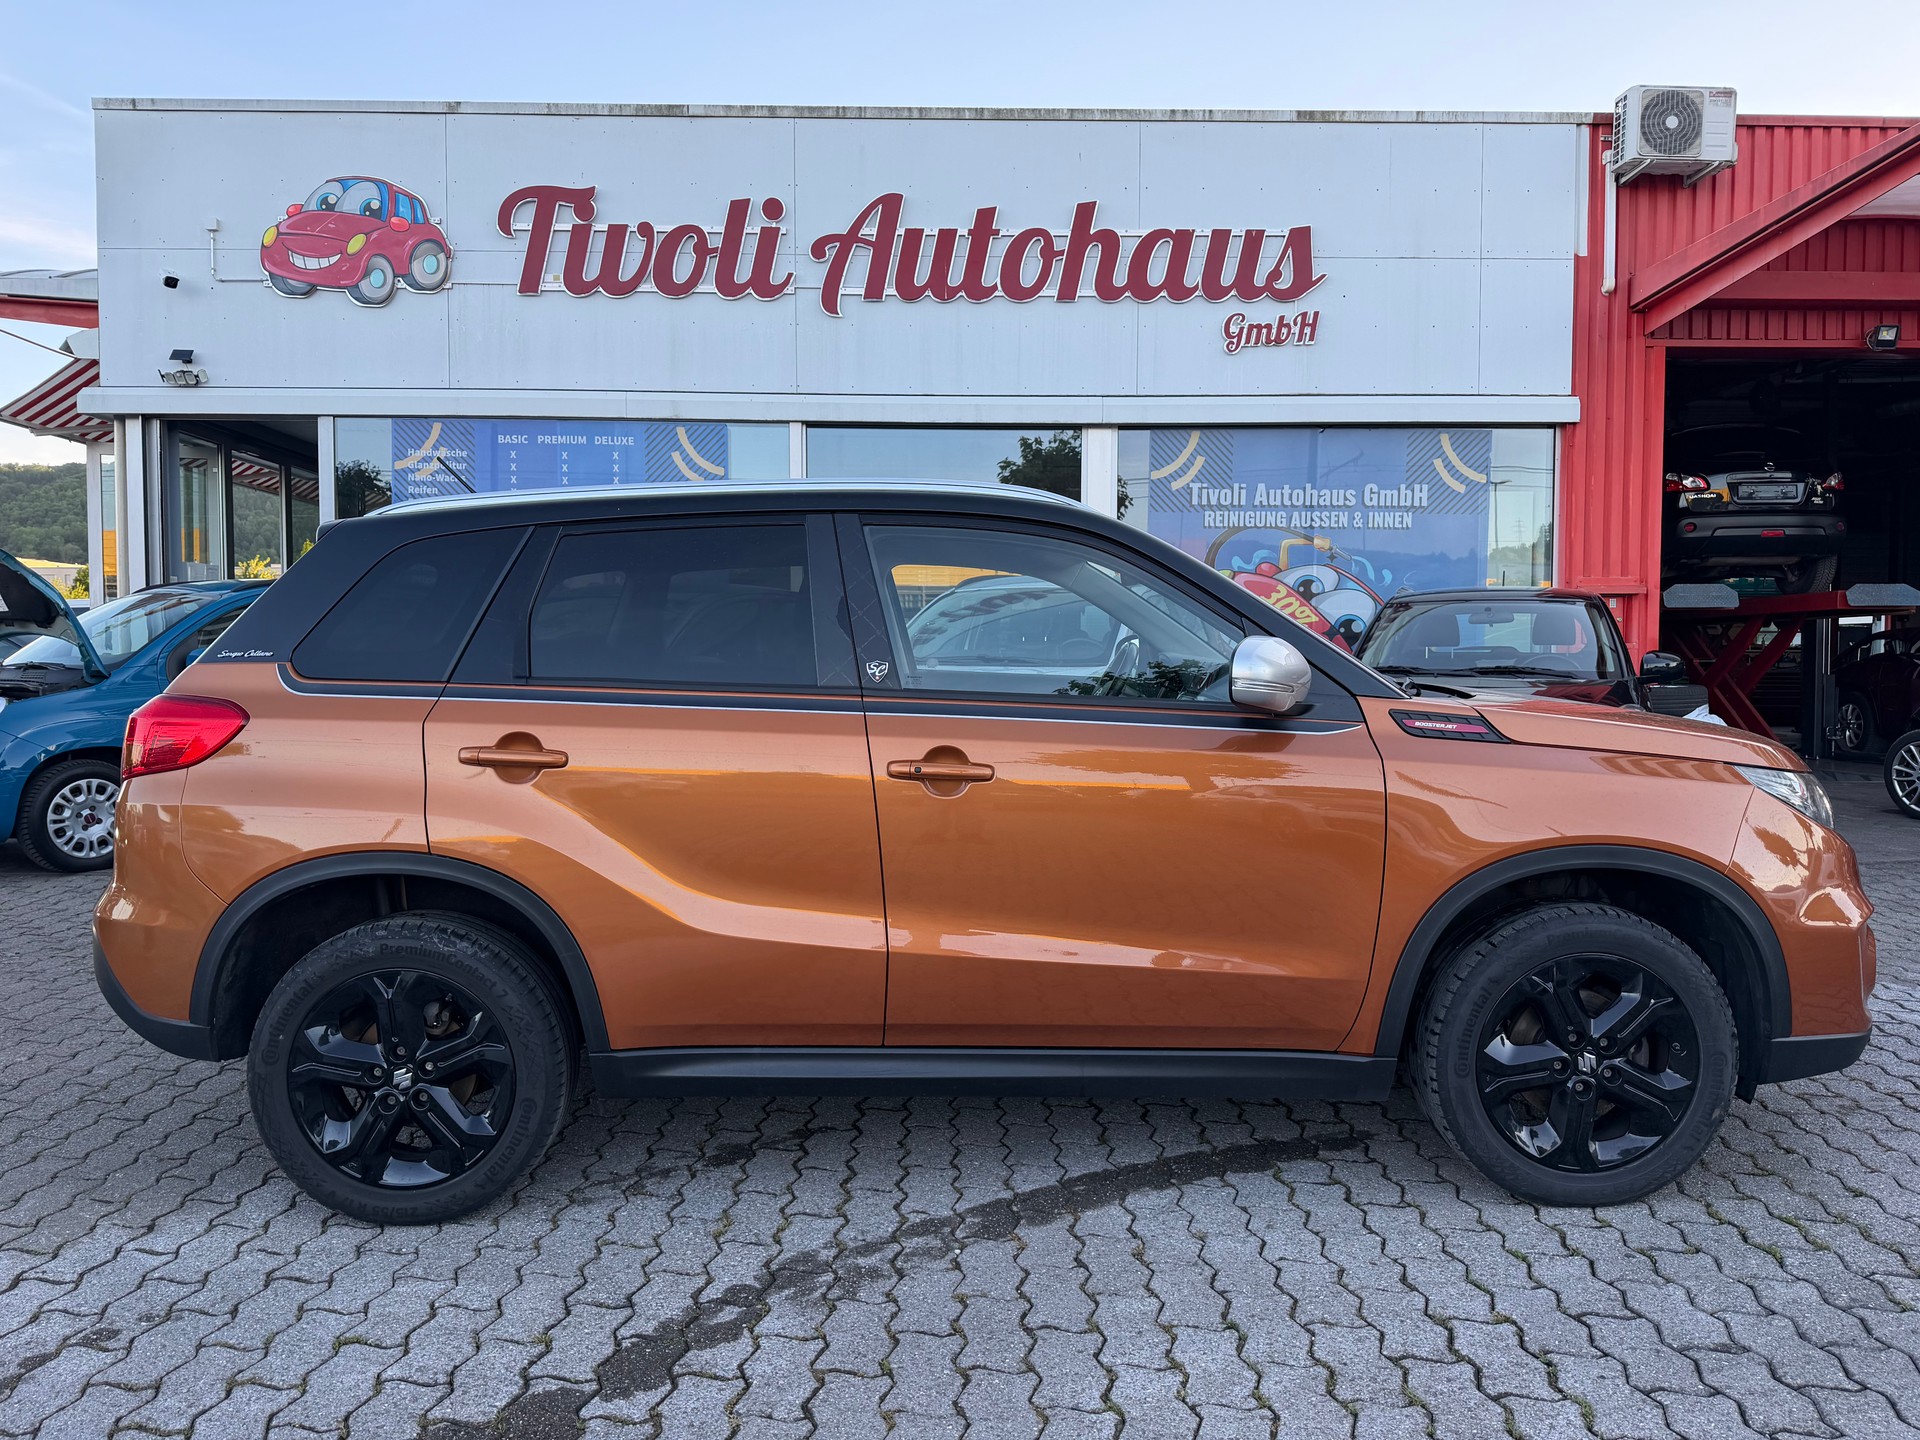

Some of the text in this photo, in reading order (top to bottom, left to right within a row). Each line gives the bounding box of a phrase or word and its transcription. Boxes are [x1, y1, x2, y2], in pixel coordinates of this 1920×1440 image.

[496, 185, 1328, 318] Tivoli Autohaus
[1222, 310, 1320, 354] GmbH
[497, 435, 635, 446] BASIC PREMIUM DELUXE
[407, 472, 466, 482] Nano-Wacs
[408, 485, 438, 494] Reifen
[1189, 482, 1429, 507] Tivoli Autohaus GmbH
[1204, 510, 1413, 528] REINIGUNG AUSSEN & INNEN
[1414, 721, 1458, 730] BOOSTERJET
[379, 943, 498, 991] PremiumContact
[261, 979, 316, 1066] Continental
[1454, 986, 1493, 1079] Continental
[483, 1098, 538, 1183] Continental
